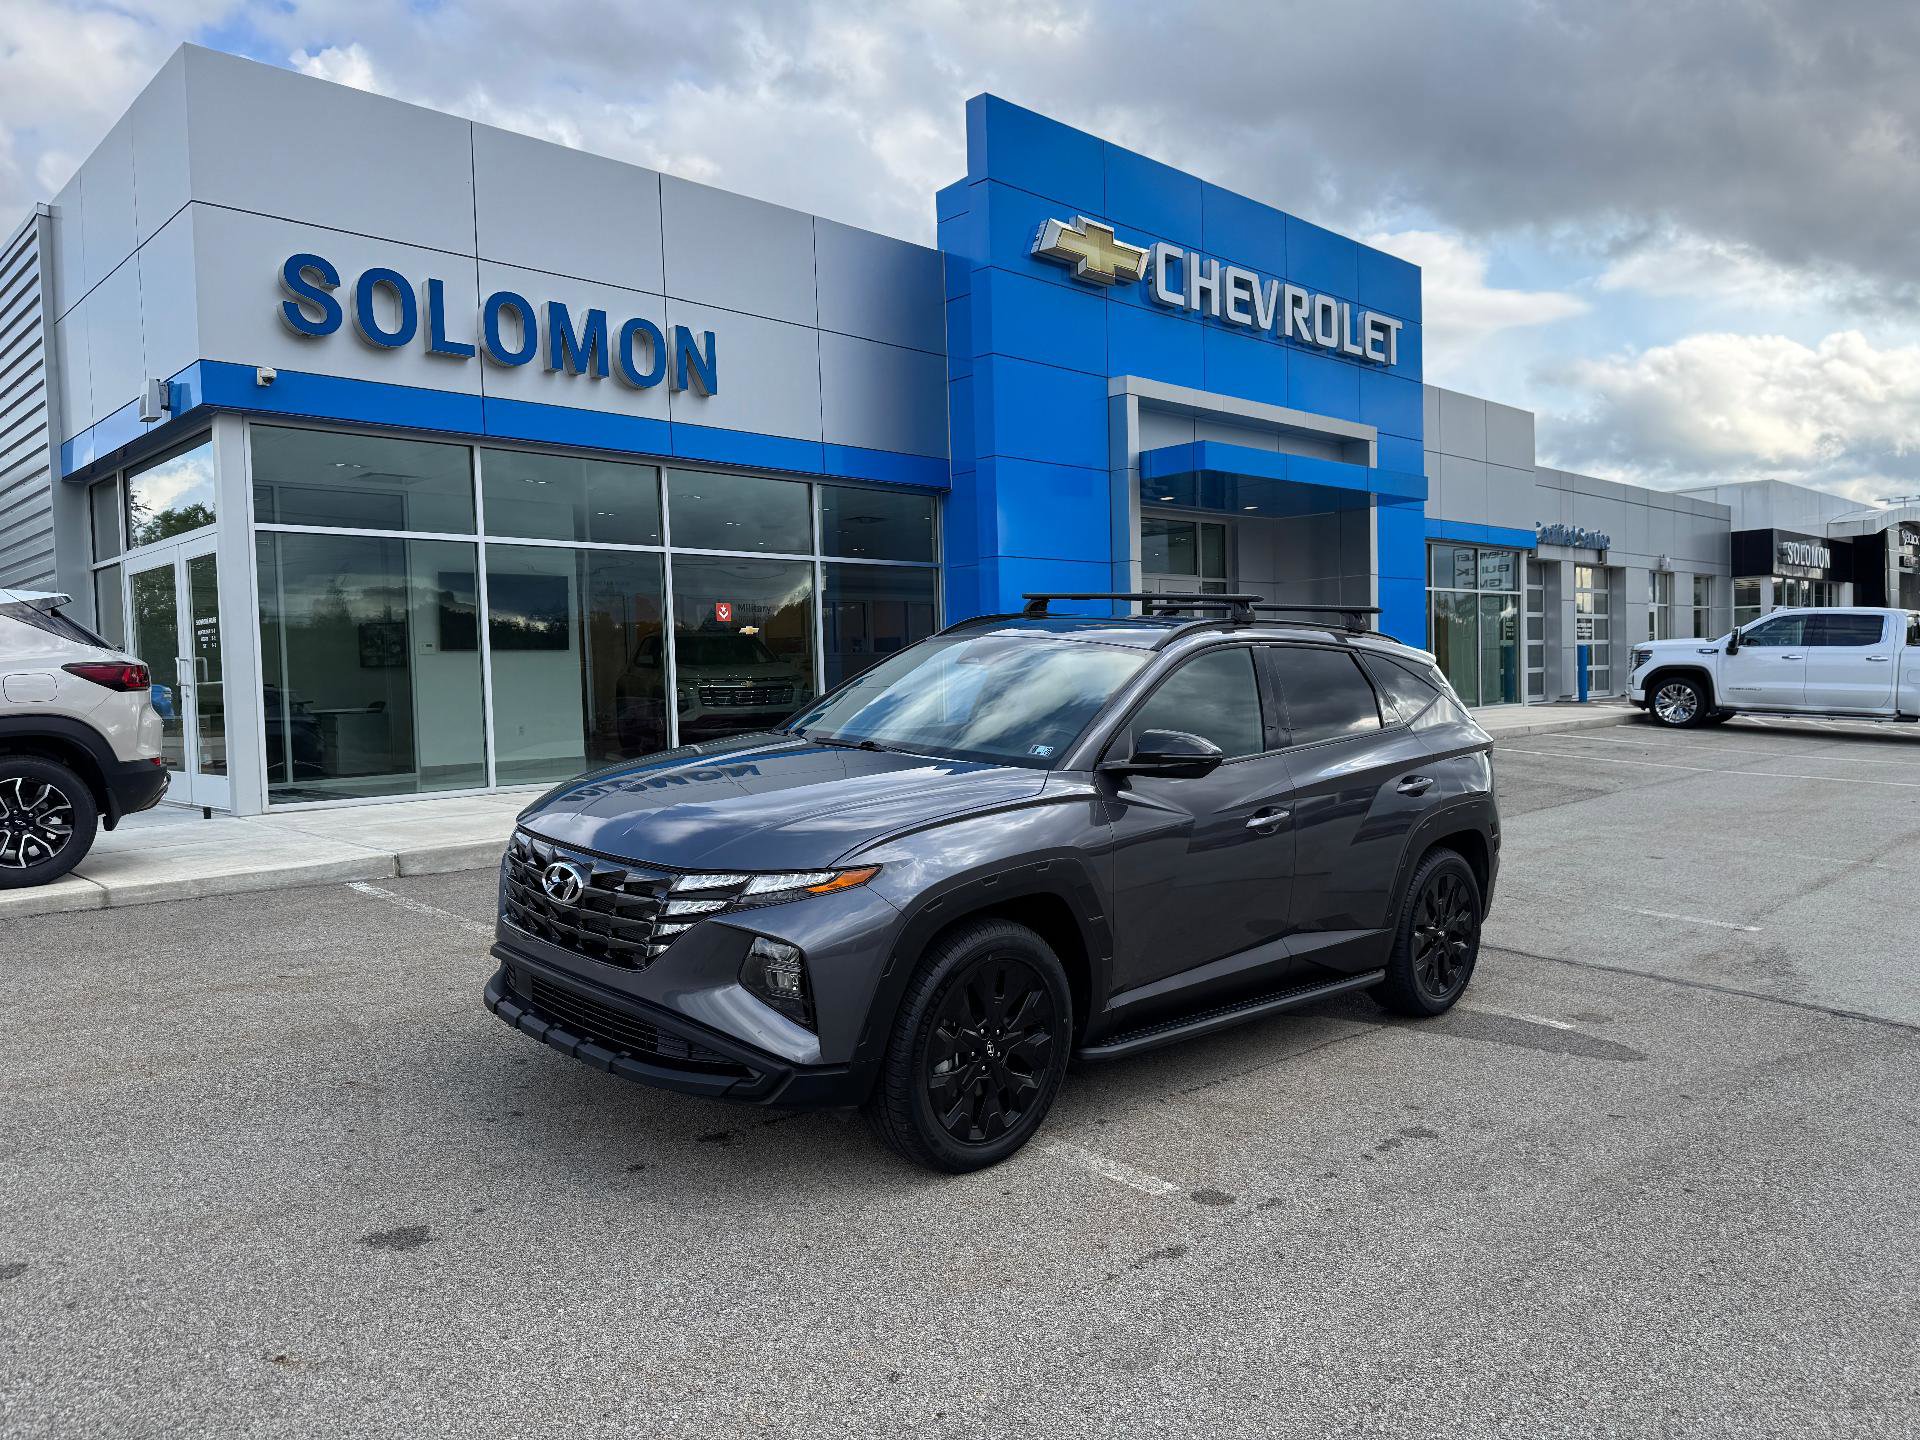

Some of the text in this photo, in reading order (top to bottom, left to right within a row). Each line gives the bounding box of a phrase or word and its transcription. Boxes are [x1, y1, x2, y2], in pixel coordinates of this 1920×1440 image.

[278, 253, 718, 396] SOLOMON
[1150, 242, 1403, 366] CHEVROLET
[1787, 541, 1831, 569] SOLOMON
[738, 603, 772, 614] Military
